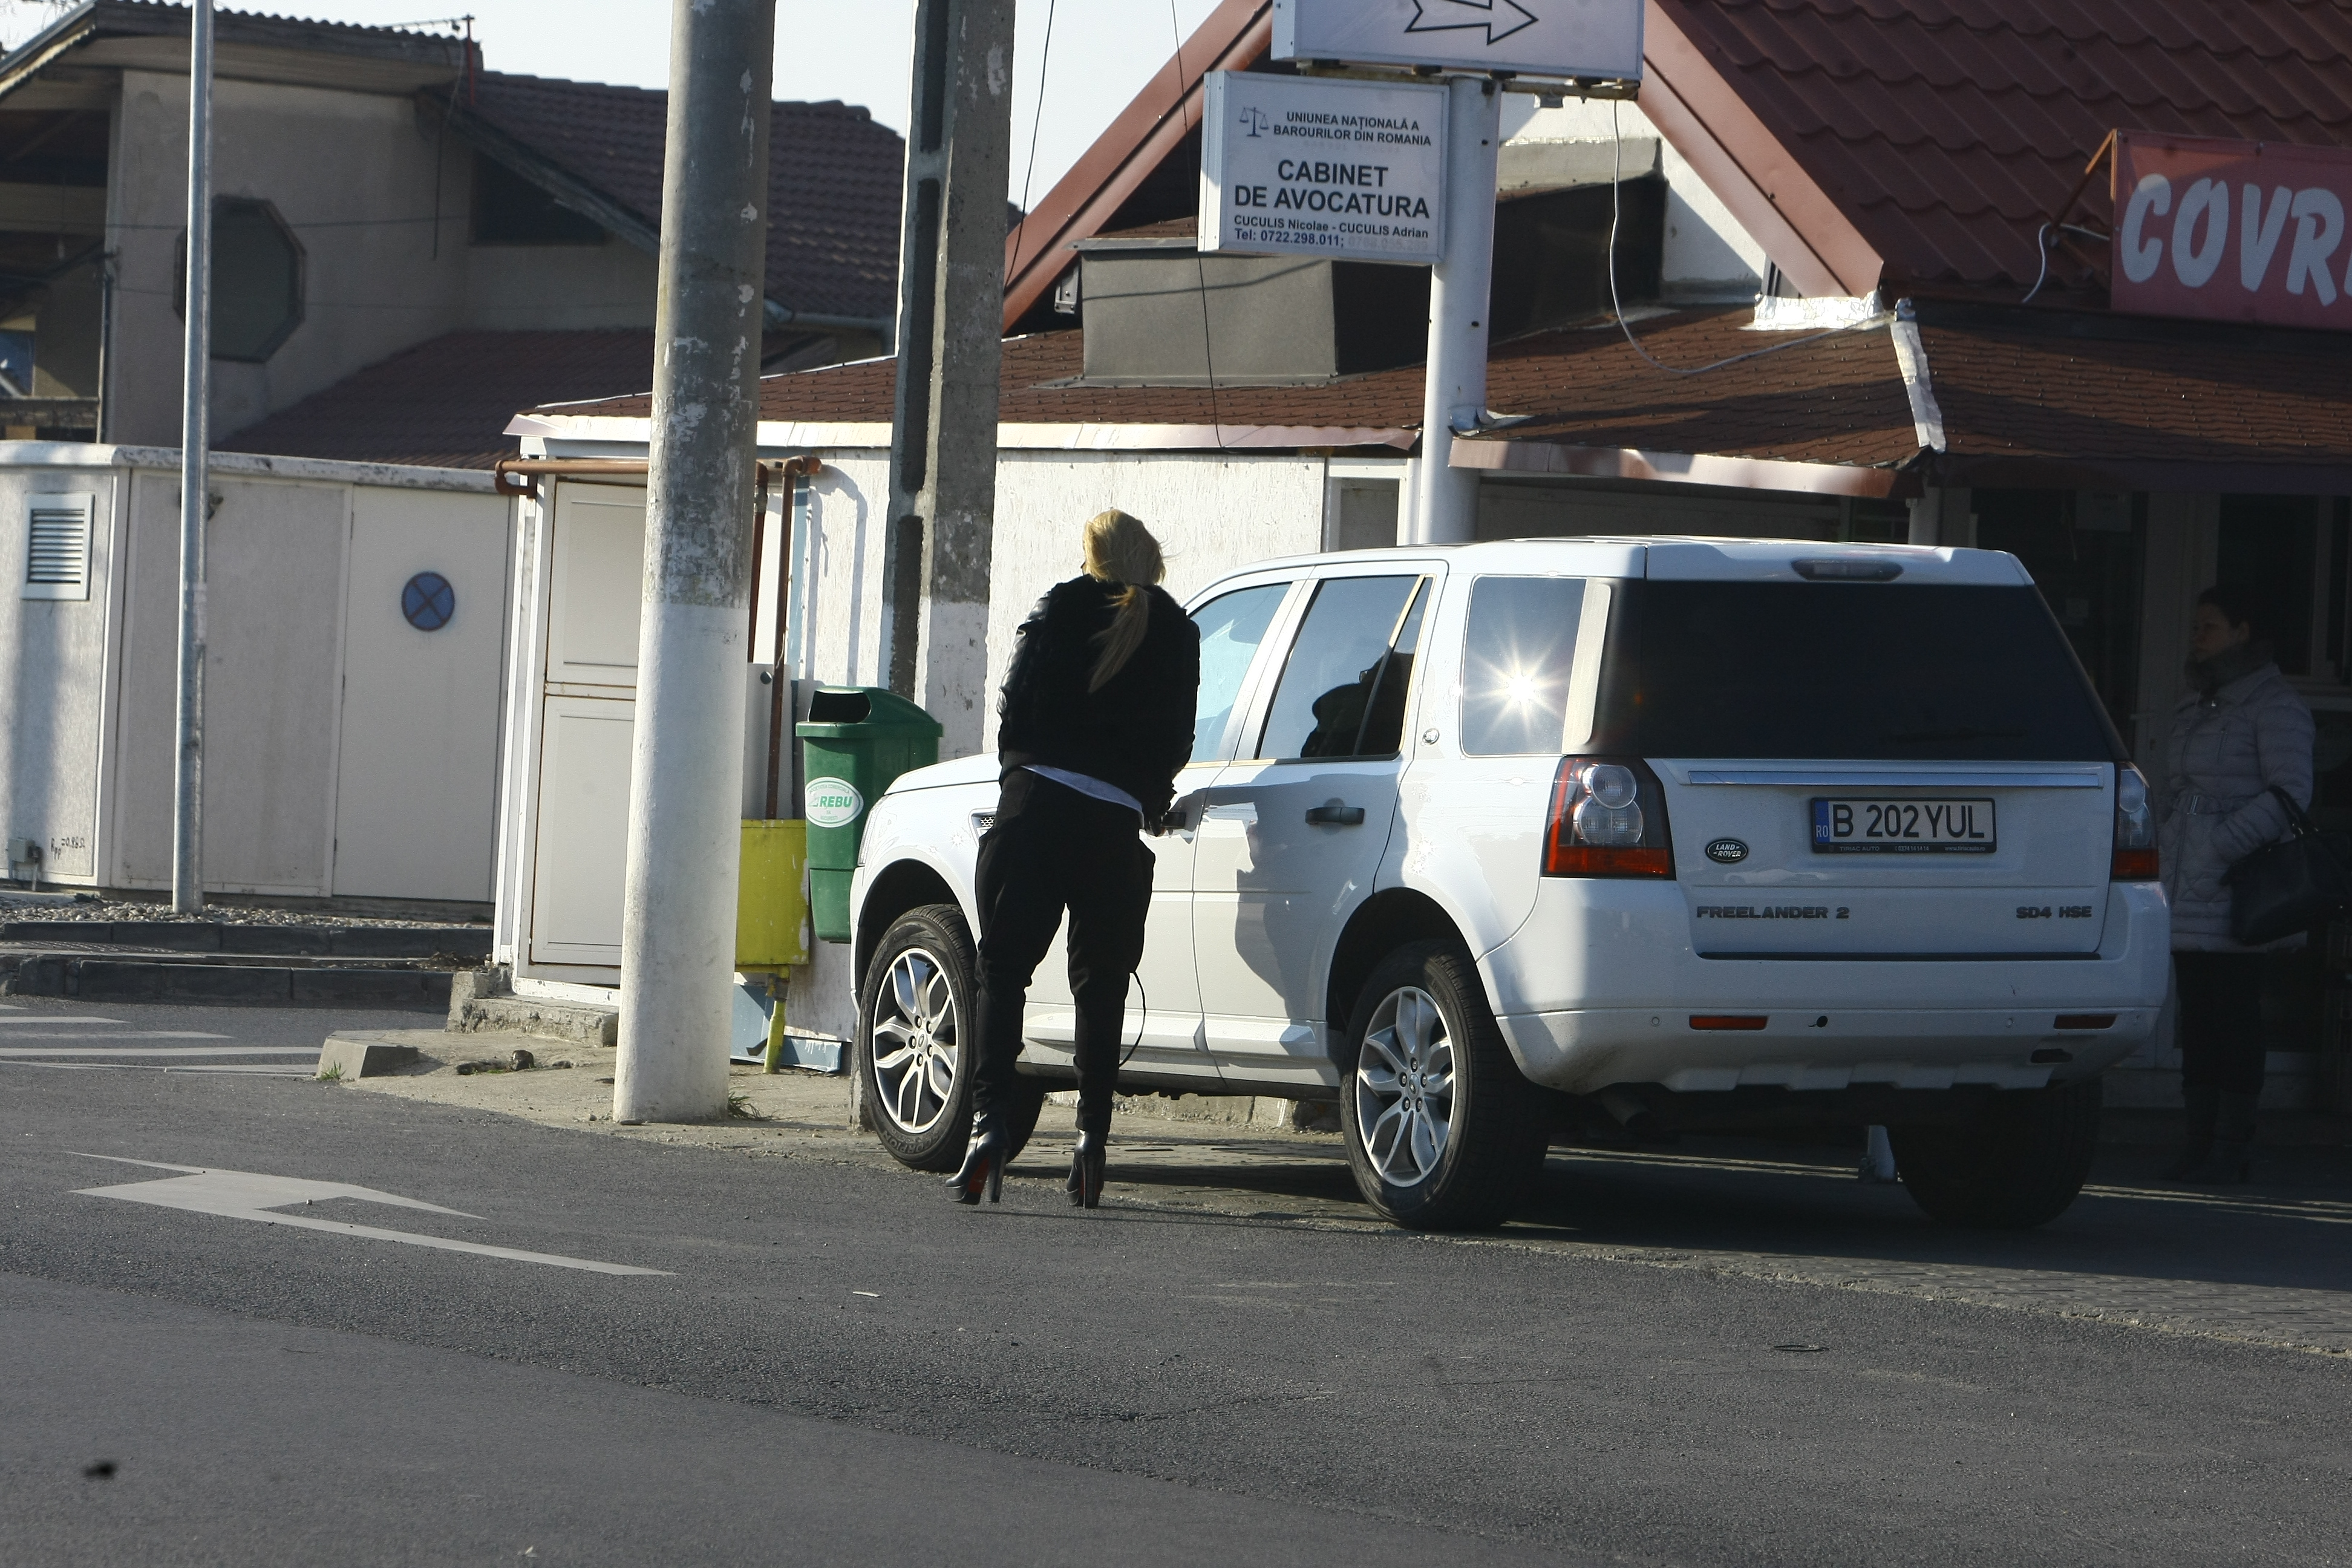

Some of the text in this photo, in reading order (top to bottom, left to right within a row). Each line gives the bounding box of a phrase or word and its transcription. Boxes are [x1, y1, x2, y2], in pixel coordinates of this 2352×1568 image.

[1287, 112, 1338, 125] UNIUNEA
[1411, 121, 1420, 131] A
[1274, 125, 1431, 146] BAROURILOR DIN ROMANIA
[1278, 160, 1388, 188] CABINET
[1234, 185, 1429, 218] DE AVOCATURA
[1234, 215, 1284, 228] CUCULIS
[1288, 218, 1328, 231] Nicolae
[1339, 223, 1390, 235] CUCULIS
[1392, 226, 1429, 238] Adrian
[1234, 228, 1256, 241] Tel:
[1261, 230, 1344, 247] 0722.298.011;
[2121, 173, 2352, 307] COVR
[819, 795, 853, 808] REBU
[1832, 804, 1854, 837] B
[1816, 825, 1828, 837] RO
[1696, 906, 1850, 919] FREELANDER 2
[2016, 906, 2092, 919] SD4 HSE
